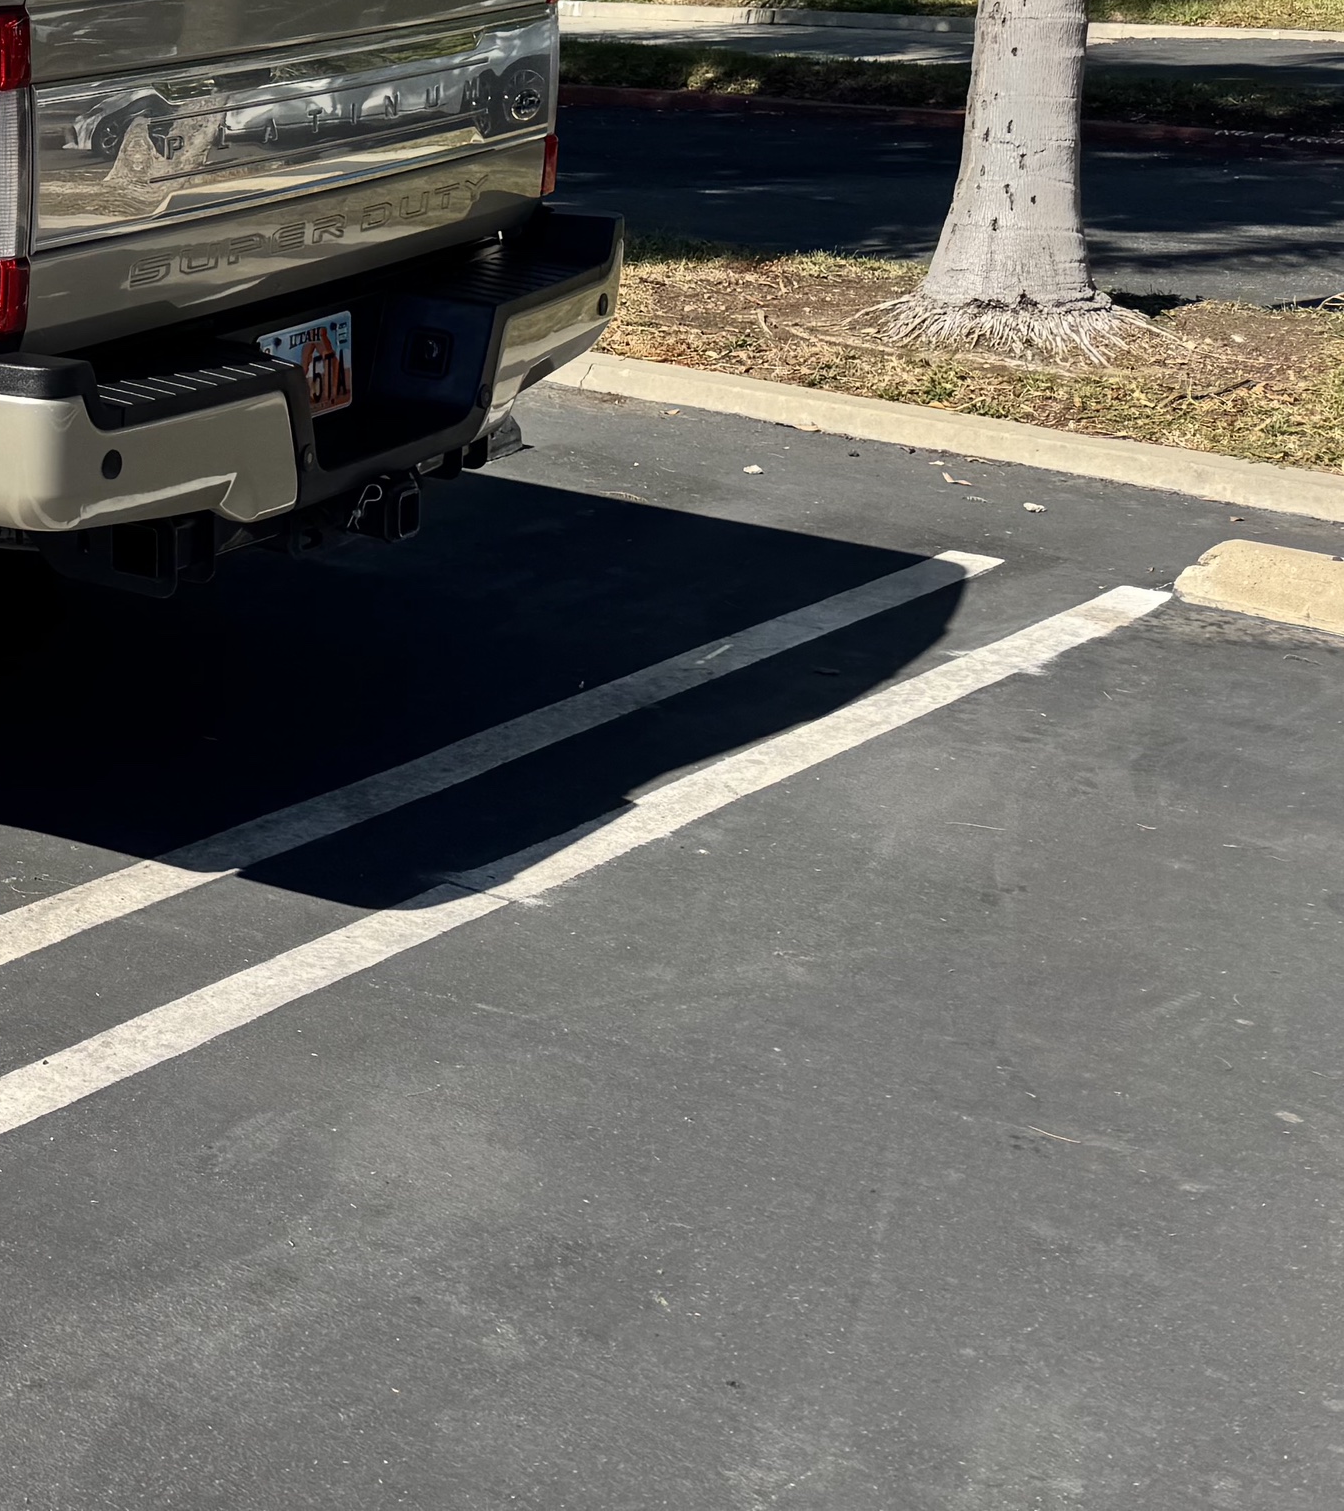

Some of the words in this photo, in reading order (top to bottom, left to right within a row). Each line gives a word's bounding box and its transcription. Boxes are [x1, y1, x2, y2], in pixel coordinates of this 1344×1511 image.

[164, 76, 481, 160] PLATINUM
[128, 213, 347, 289] SUPER
[361, 174, 488, 232] DUTY
[289, 327, 321, 349] UTAH
